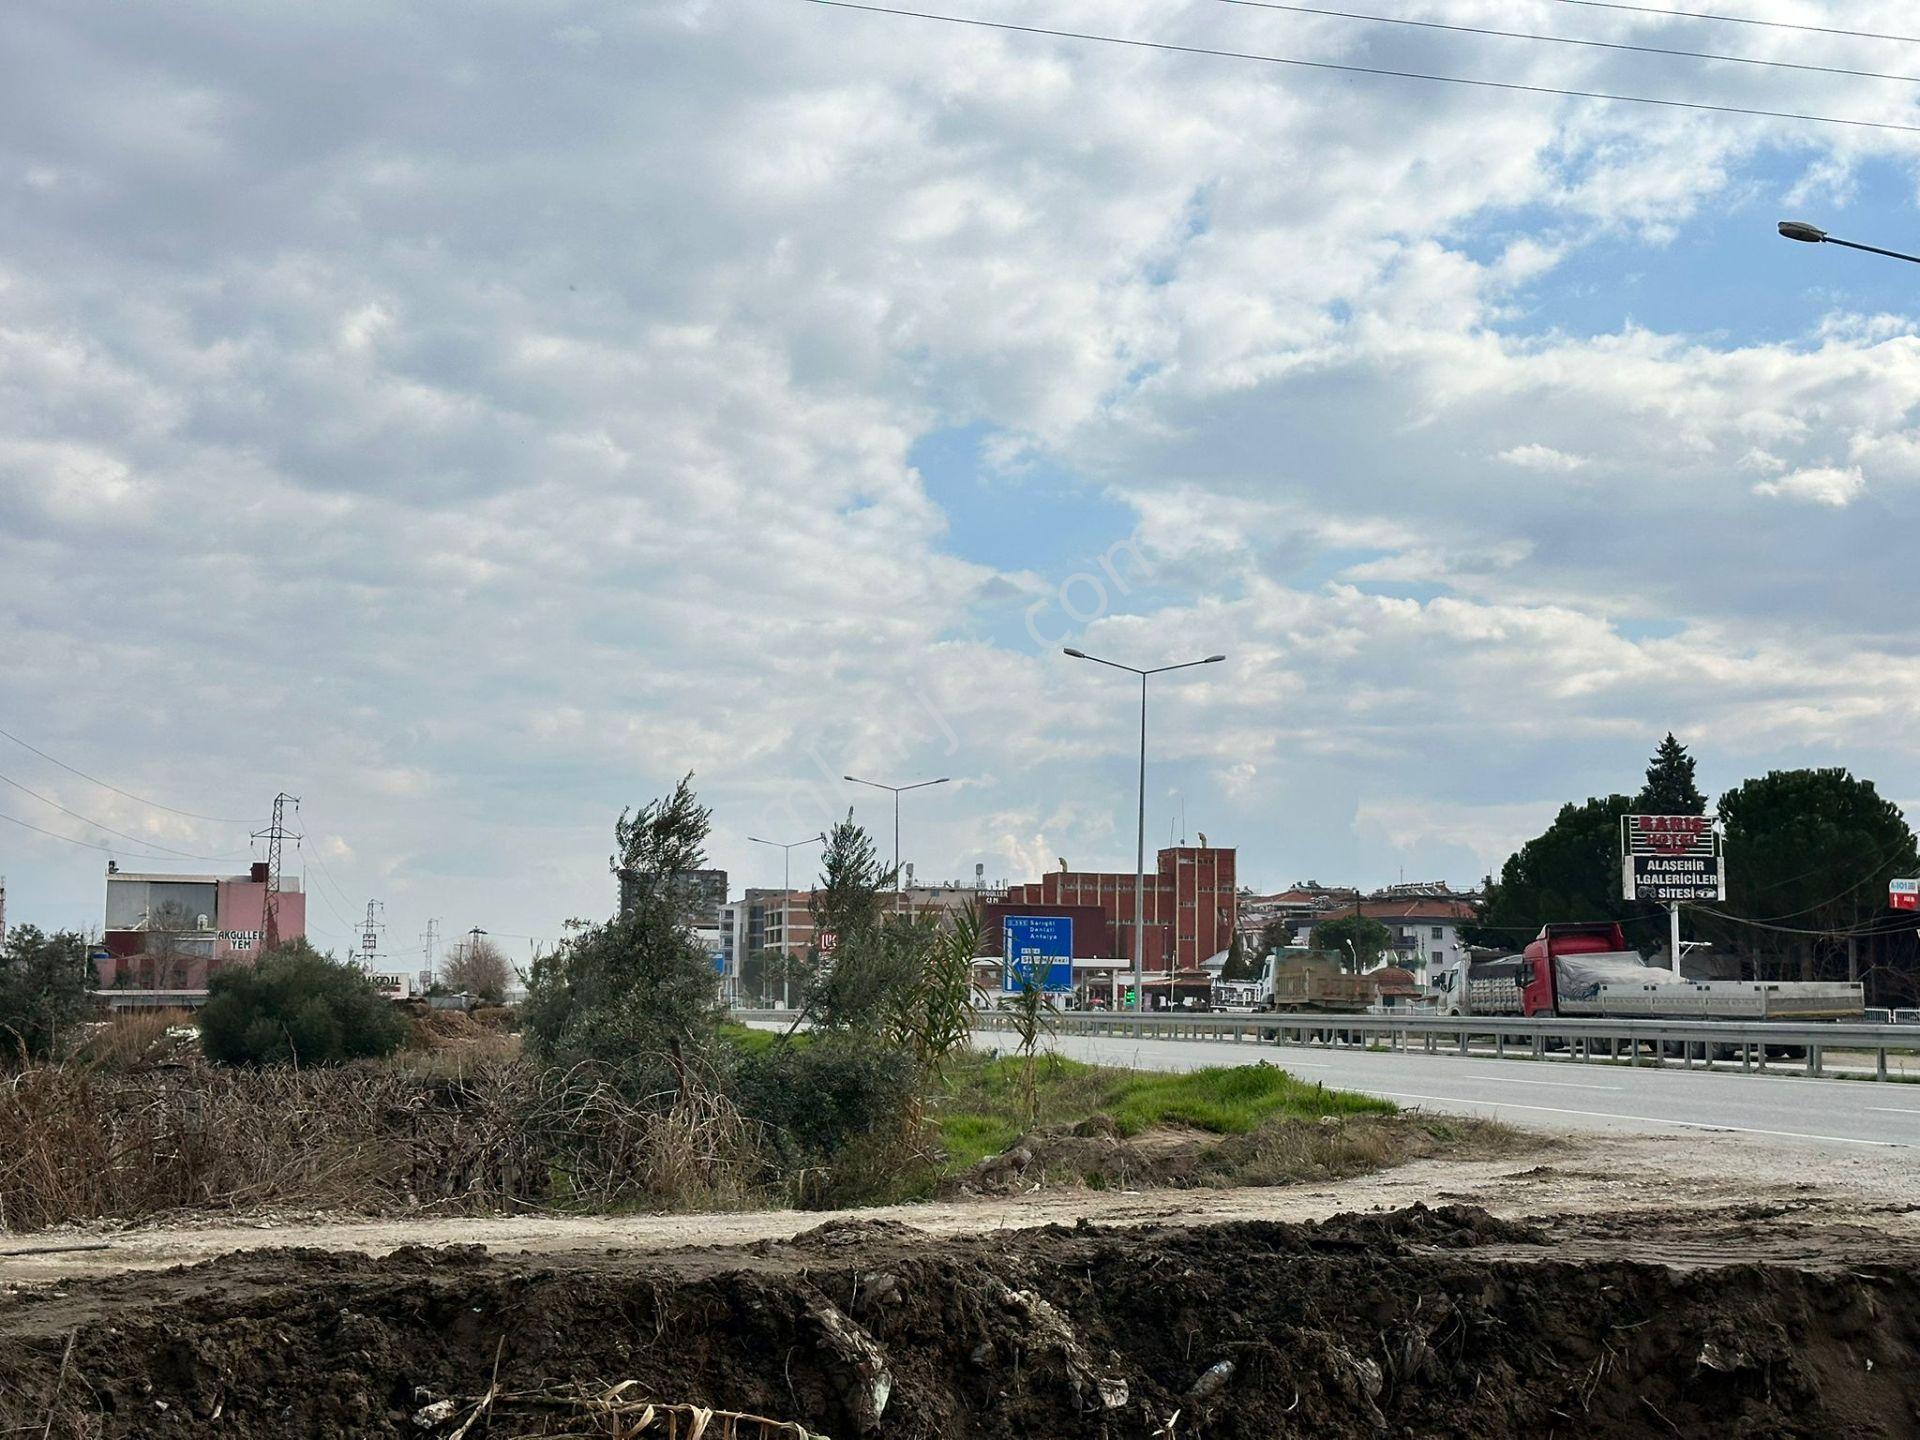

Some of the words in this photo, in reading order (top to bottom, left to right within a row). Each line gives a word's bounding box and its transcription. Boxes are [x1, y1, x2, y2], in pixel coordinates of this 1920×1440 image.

[1647, 859, 1704, 871] ALAŞEHİR
[1658, 887, 1694, 899] SİTESİ
[1030, 933, 1057, 941] Antalya
[231, 940, 251, 950] YEM
